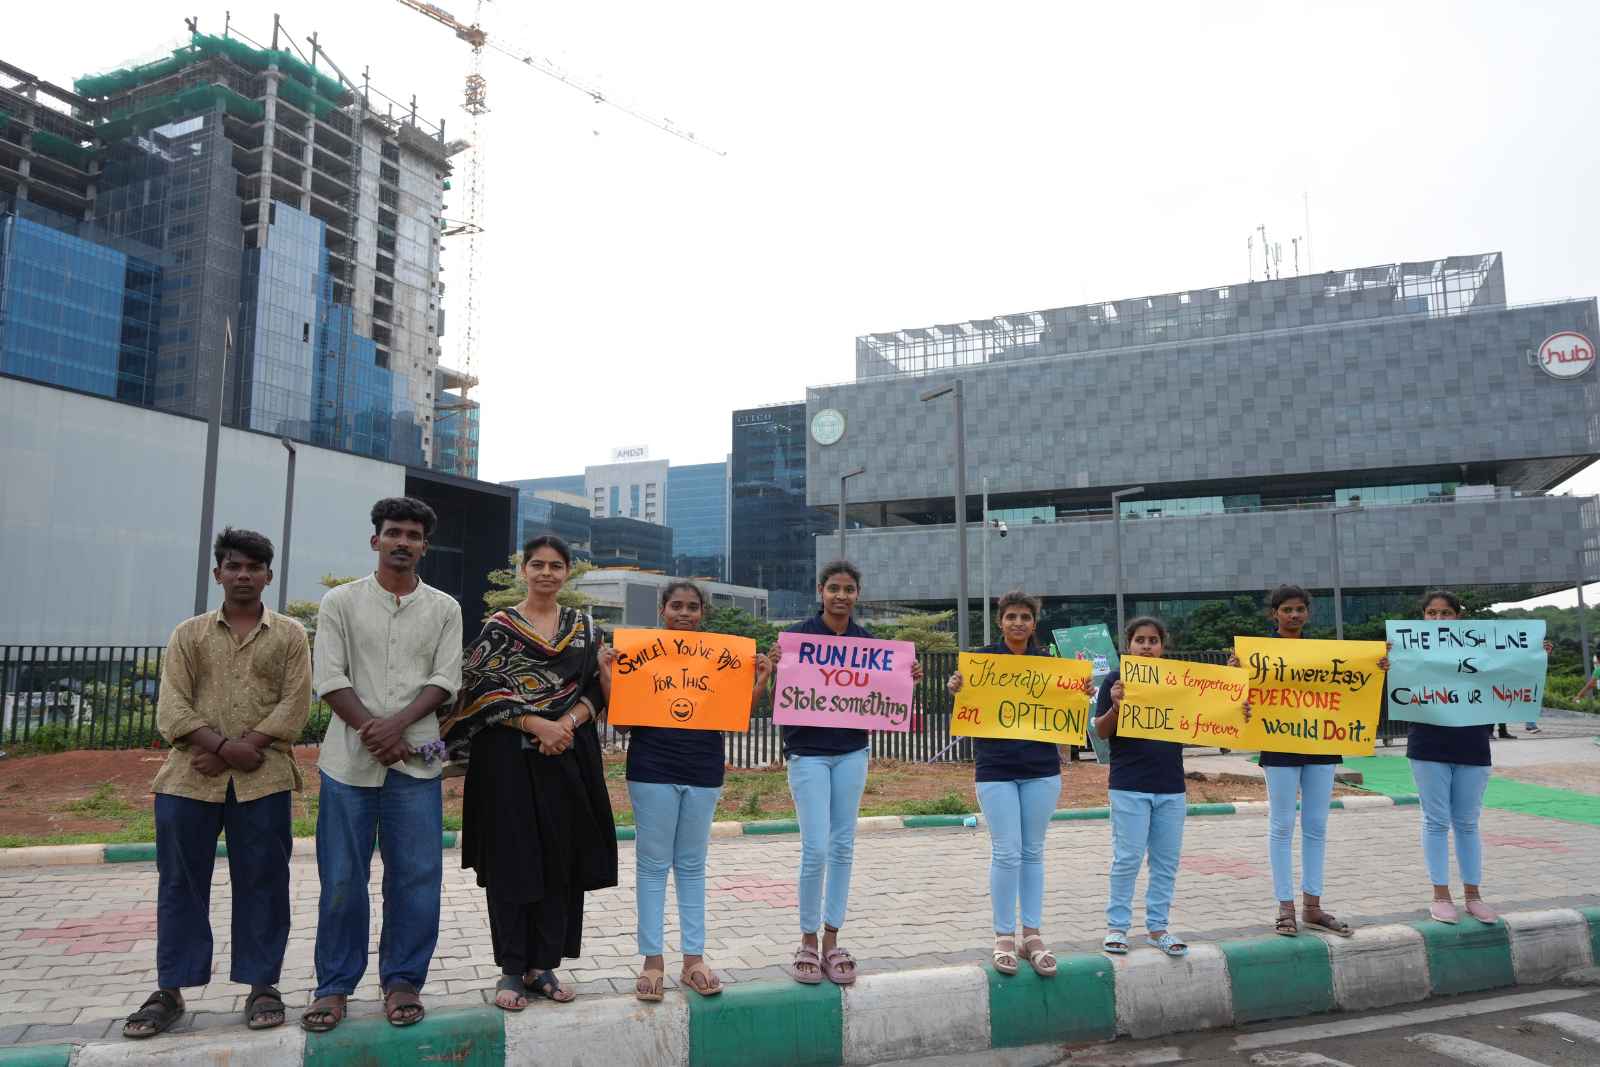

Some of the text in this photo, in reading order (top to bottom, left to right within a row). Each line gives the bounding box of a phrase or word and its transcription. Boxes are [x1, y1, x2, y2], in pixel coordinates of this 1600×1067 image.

[617, 638, 667, 675] SMILE!
[799, 642, 847, 667] RUN
[1395, 628, 1430, 650] THE
[653, 673, 678, 694] FOR
[819, 669, 869, 687] YOU
[969, 658, 1051, 698] Therapy
[1124, 660, 1160, 685] PAIN
[1165, 671, 1178, 686] is
[1183, 669, 1245, 702] temporary
[1249, 652, 1372, 692] If it were Easy
[779, 686, 908, 725] Stole something
[1247, 687, 1342, 711] EVERYONE
[957, 700, 1086, 740] an OPTION!
[1121, 703, 1240, 739] PRIDE is forever
[1322, 719, 1347, 741] Do
